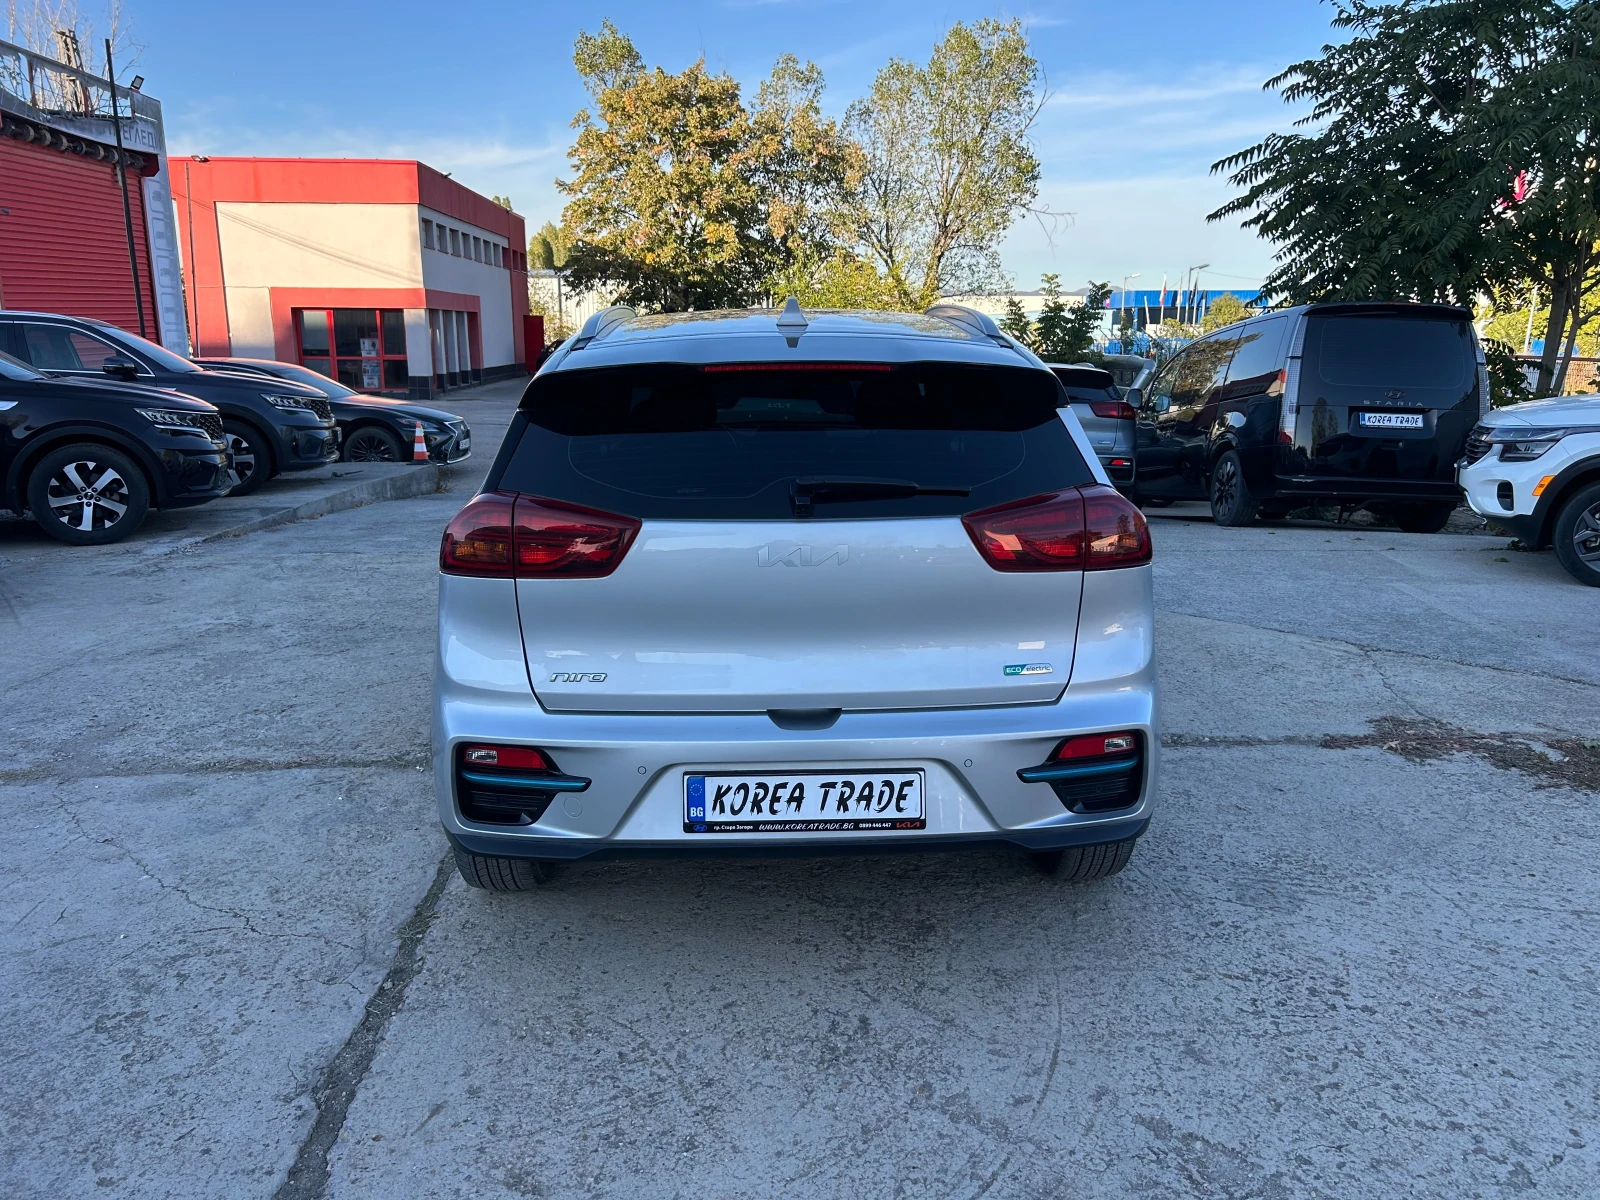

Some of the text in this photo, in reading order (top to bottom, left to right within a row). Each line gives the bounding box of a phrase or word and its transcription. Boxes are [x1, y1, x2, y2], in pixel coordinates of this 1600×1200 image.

[1366, 415, 1392, 424] KOREA
[1394, 416, 1420, 425] TRADE
[757, 544, 849, 567] KIA
[711, 779, 915, 816] KOREA TRADE
[690, 806, 704, 817] BG
[758, 822, 855, 831] WWW.KOREATRADE.BG
[896, 821, 920, 829] KIA
